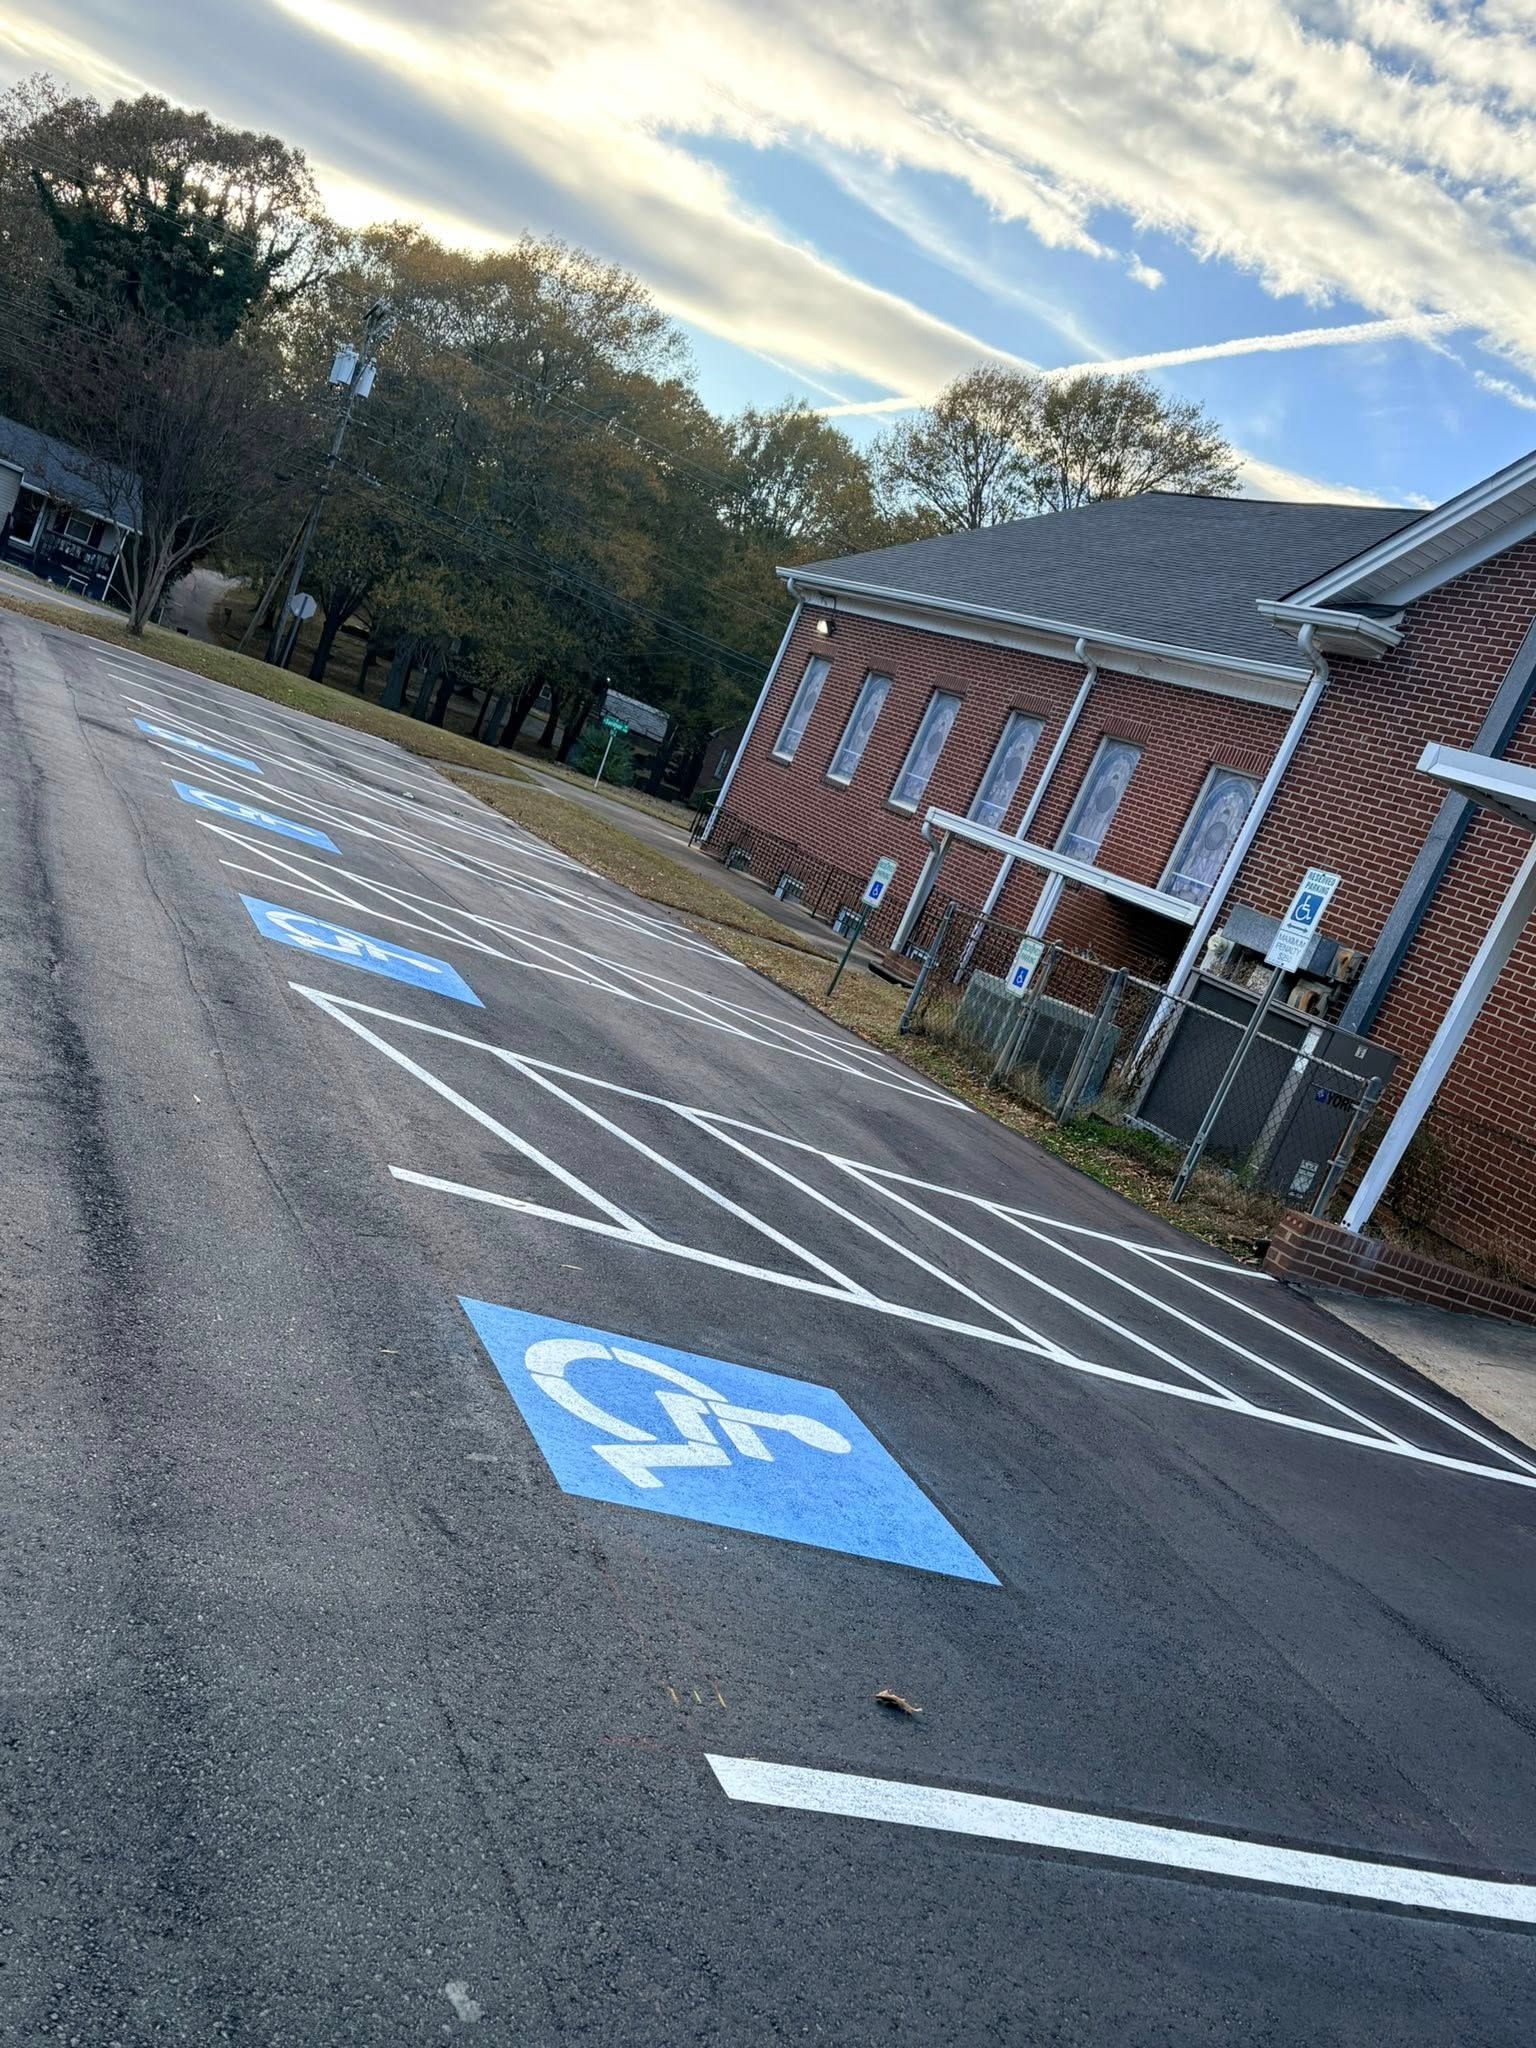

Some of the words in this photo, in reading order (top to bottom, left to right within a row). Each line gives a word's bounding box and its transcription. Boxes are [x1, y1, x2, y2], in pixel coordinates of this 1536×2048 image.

[1307, 871, 1336, 887] RESERVED
[1305, 881, 1331, 896] PARKING
[1275, 942, 1301, 956] PENALTY
